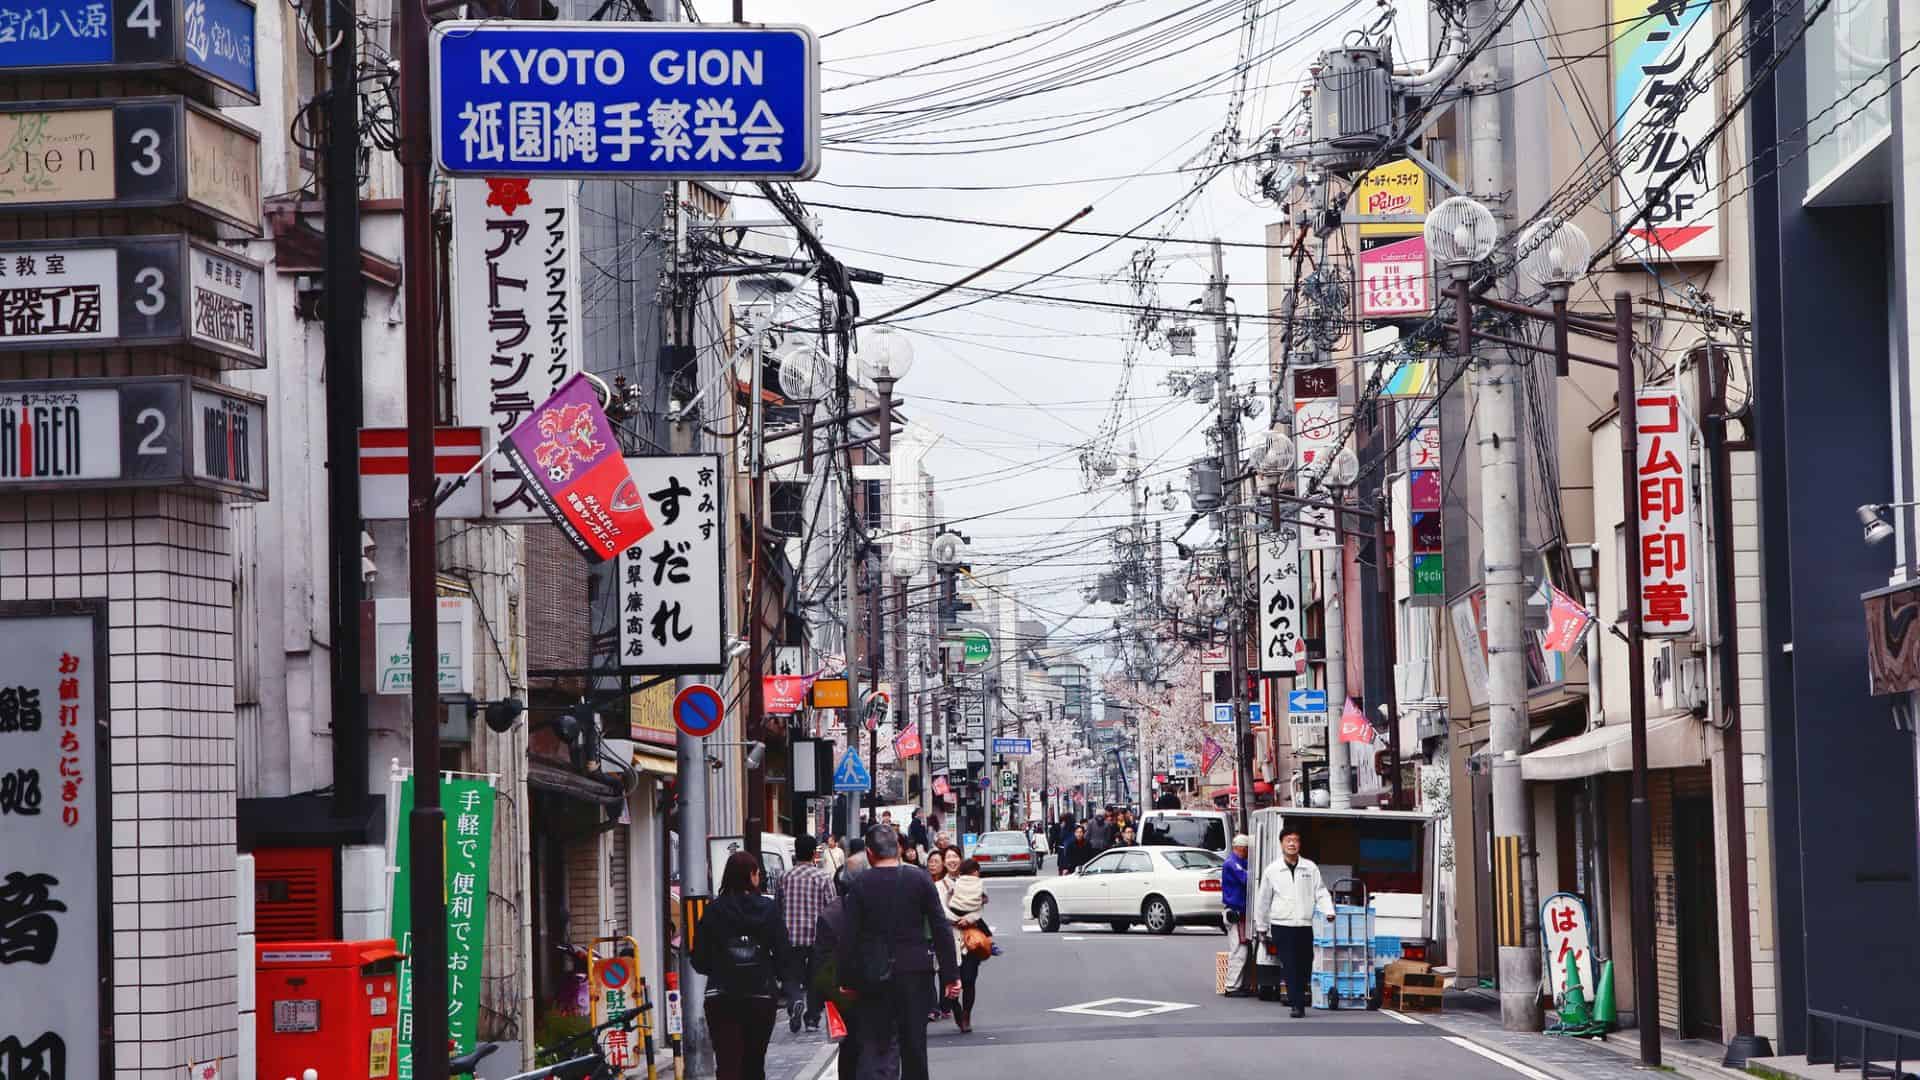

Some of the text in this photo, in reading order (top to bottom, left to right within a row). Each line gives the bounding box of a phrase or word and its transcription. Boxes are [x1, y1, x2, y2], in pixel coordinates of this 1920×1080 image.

[127, 0, 162, 39] 4
[480, 48, 764, 86] KYOTO GION
[130, 128, 162, 176] 3
[458, 98, 785, 162] 祇園縄手繁栄会
[0, 136, 96, 176] ien
[1646, 186, 1695, 222] BF
[0, 285, 101, 337] 器工房
[135, 267, 165, 316] 3
[544, 207, 568, 396] ファンタスティック
[485, 219, 538, 513] アトランテス
[136, 408, 168, 455] 2
[697, 466, 715, 541] 京みす
[648, 475, 694, 647] すだれ
[58, 651, 83, 828] お値打ちにぎり
